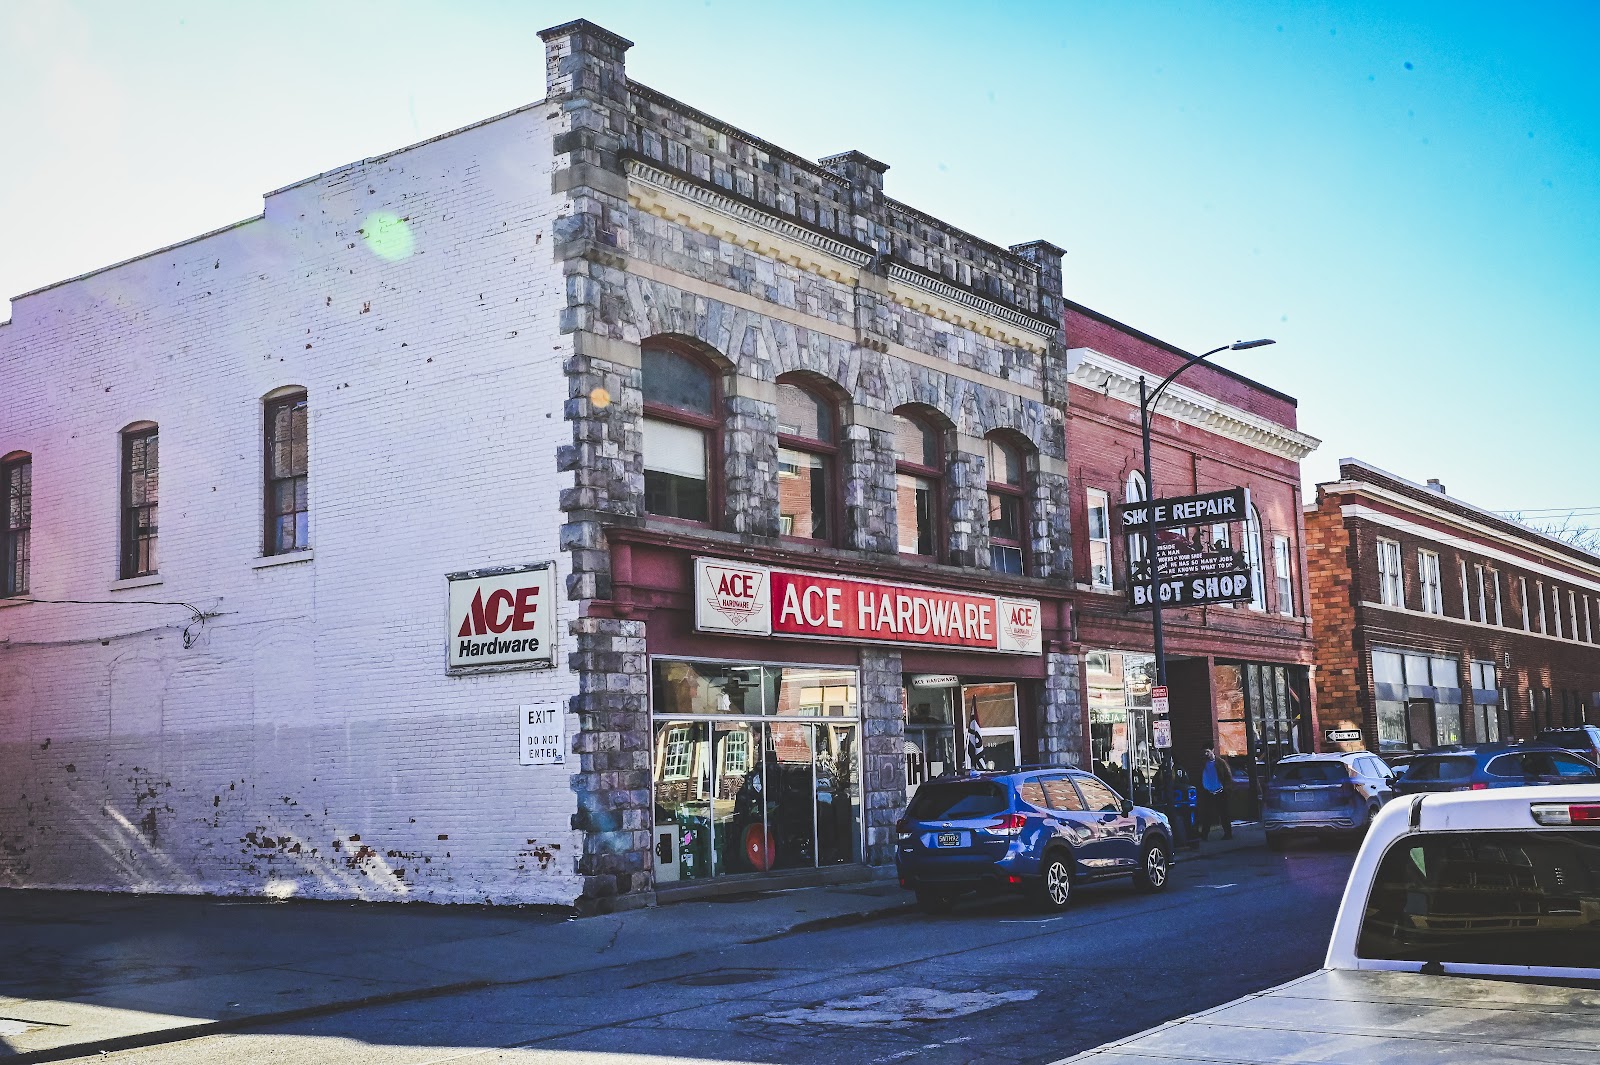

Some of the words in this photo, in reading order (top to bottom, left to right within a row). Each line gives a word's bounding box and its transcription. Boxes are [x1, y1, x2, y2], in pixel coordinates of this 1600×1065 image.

[1172, 497, 1236, 520] REPAIR
[1200, 557, 1218, 565] MANY
[717, 571, 754, 599] ACE
[1192, 574, 1248, 599] SHOP
[457, 585, 540, 638] ACE
[722, 599, 750, 609] HARDWARE
[779, 583, 844, 628] ACE
[857, 590, 993, 641] HARDWARE
[1010, 606, 1033, 628] ACE
[458, 636, 540, 658] Hardware
[926, 676, 957, 684] HARDWARE
[528, 709, 556, 725] EXIT
[527, 736, 539, 746] DO
[542, 734, 559, 745] NOT
[529, 748, 558, 759] ENTER
